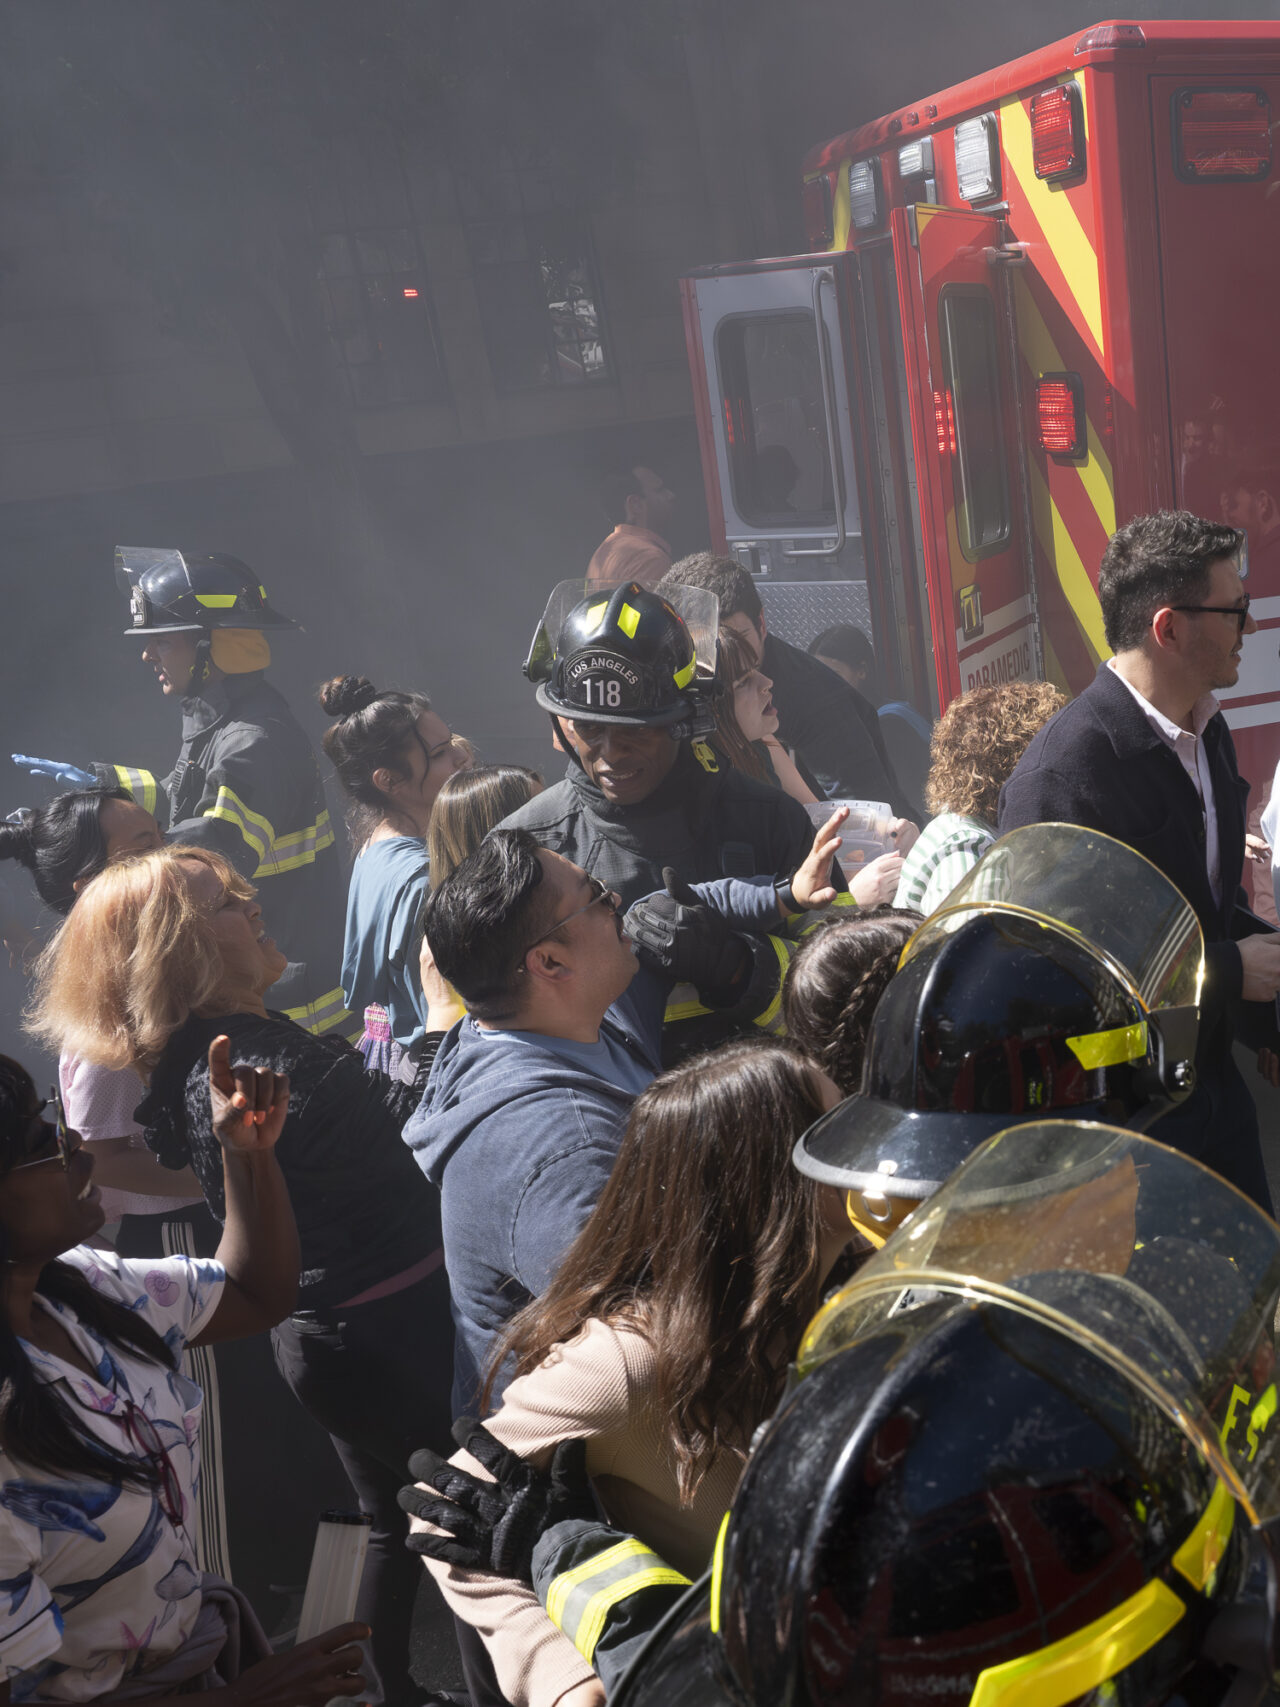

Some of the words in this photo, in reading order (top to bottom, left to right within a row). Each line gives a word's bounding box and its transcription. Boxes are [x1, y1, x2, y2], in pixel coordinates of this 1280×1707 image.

[570, 660, 588, 679] LOS
[591, 657, 639, 685] ANGELES
[967, 641, 1031, 692] PARAMEDIC
[582, 678, 621, 707] 118
